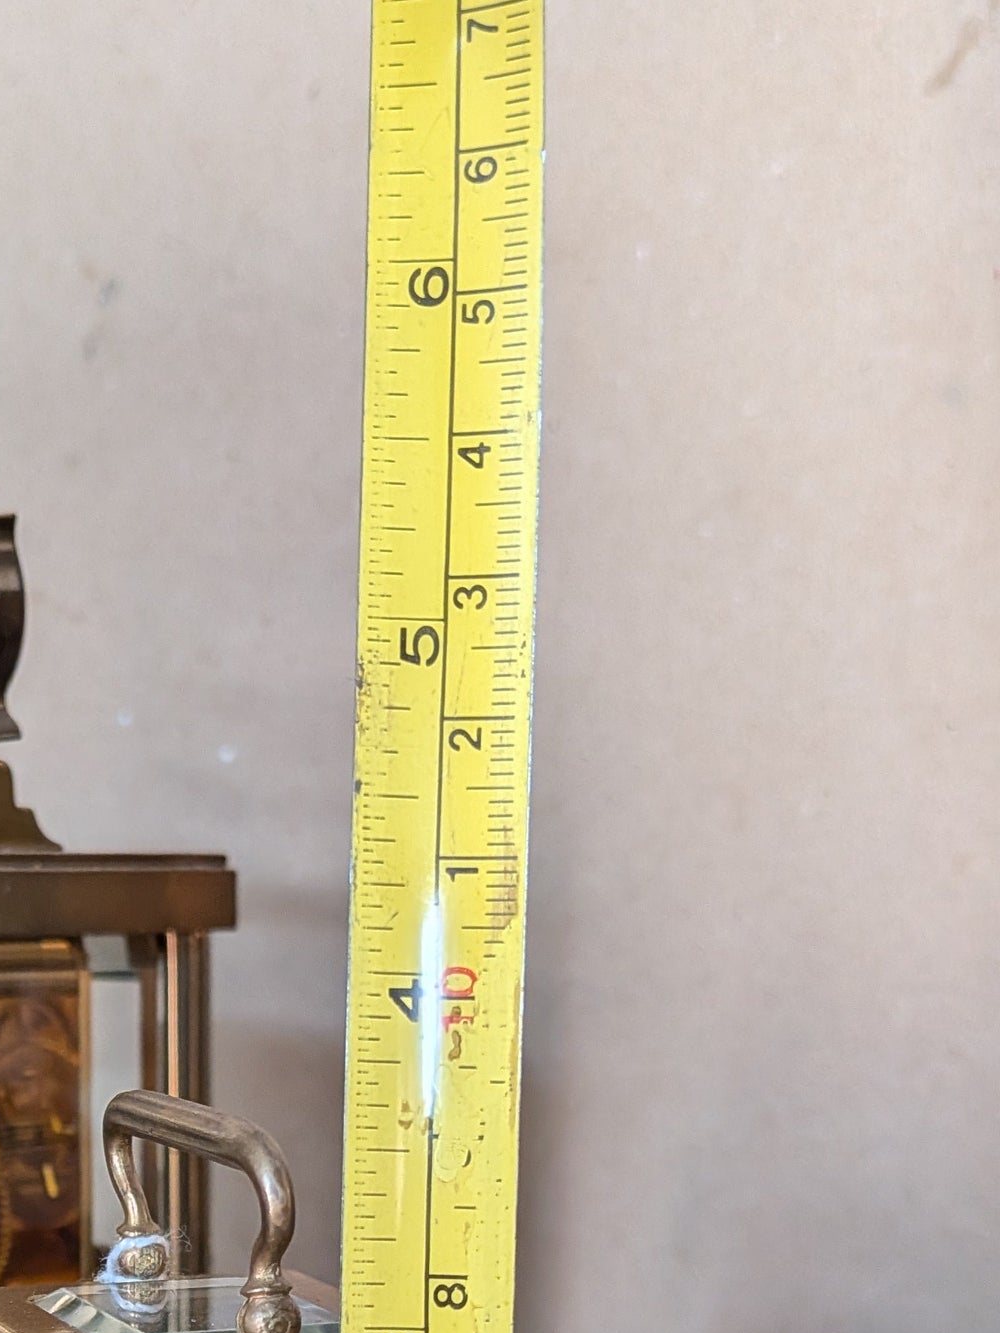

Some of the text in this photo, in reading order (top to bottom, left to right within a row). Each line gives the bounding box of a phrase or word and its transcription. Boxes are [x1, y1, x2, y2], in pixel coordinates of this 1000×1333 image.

[466, 18, 499, 43] 7
[463, 156, 498, 184] 6
[408, 266, 449, 307] 6
[461, 299, 495, 324] 5
[457, 442, 491, 469] 4
[453, 584, 487, 610] 3
[400, 625, 440, 667] 5
[448, 727, 482, 751] 2
[445, 866, 479, 882] 1
[388, 979, 425, 1022] 4
[433, 1283, 468, 1310] 8
